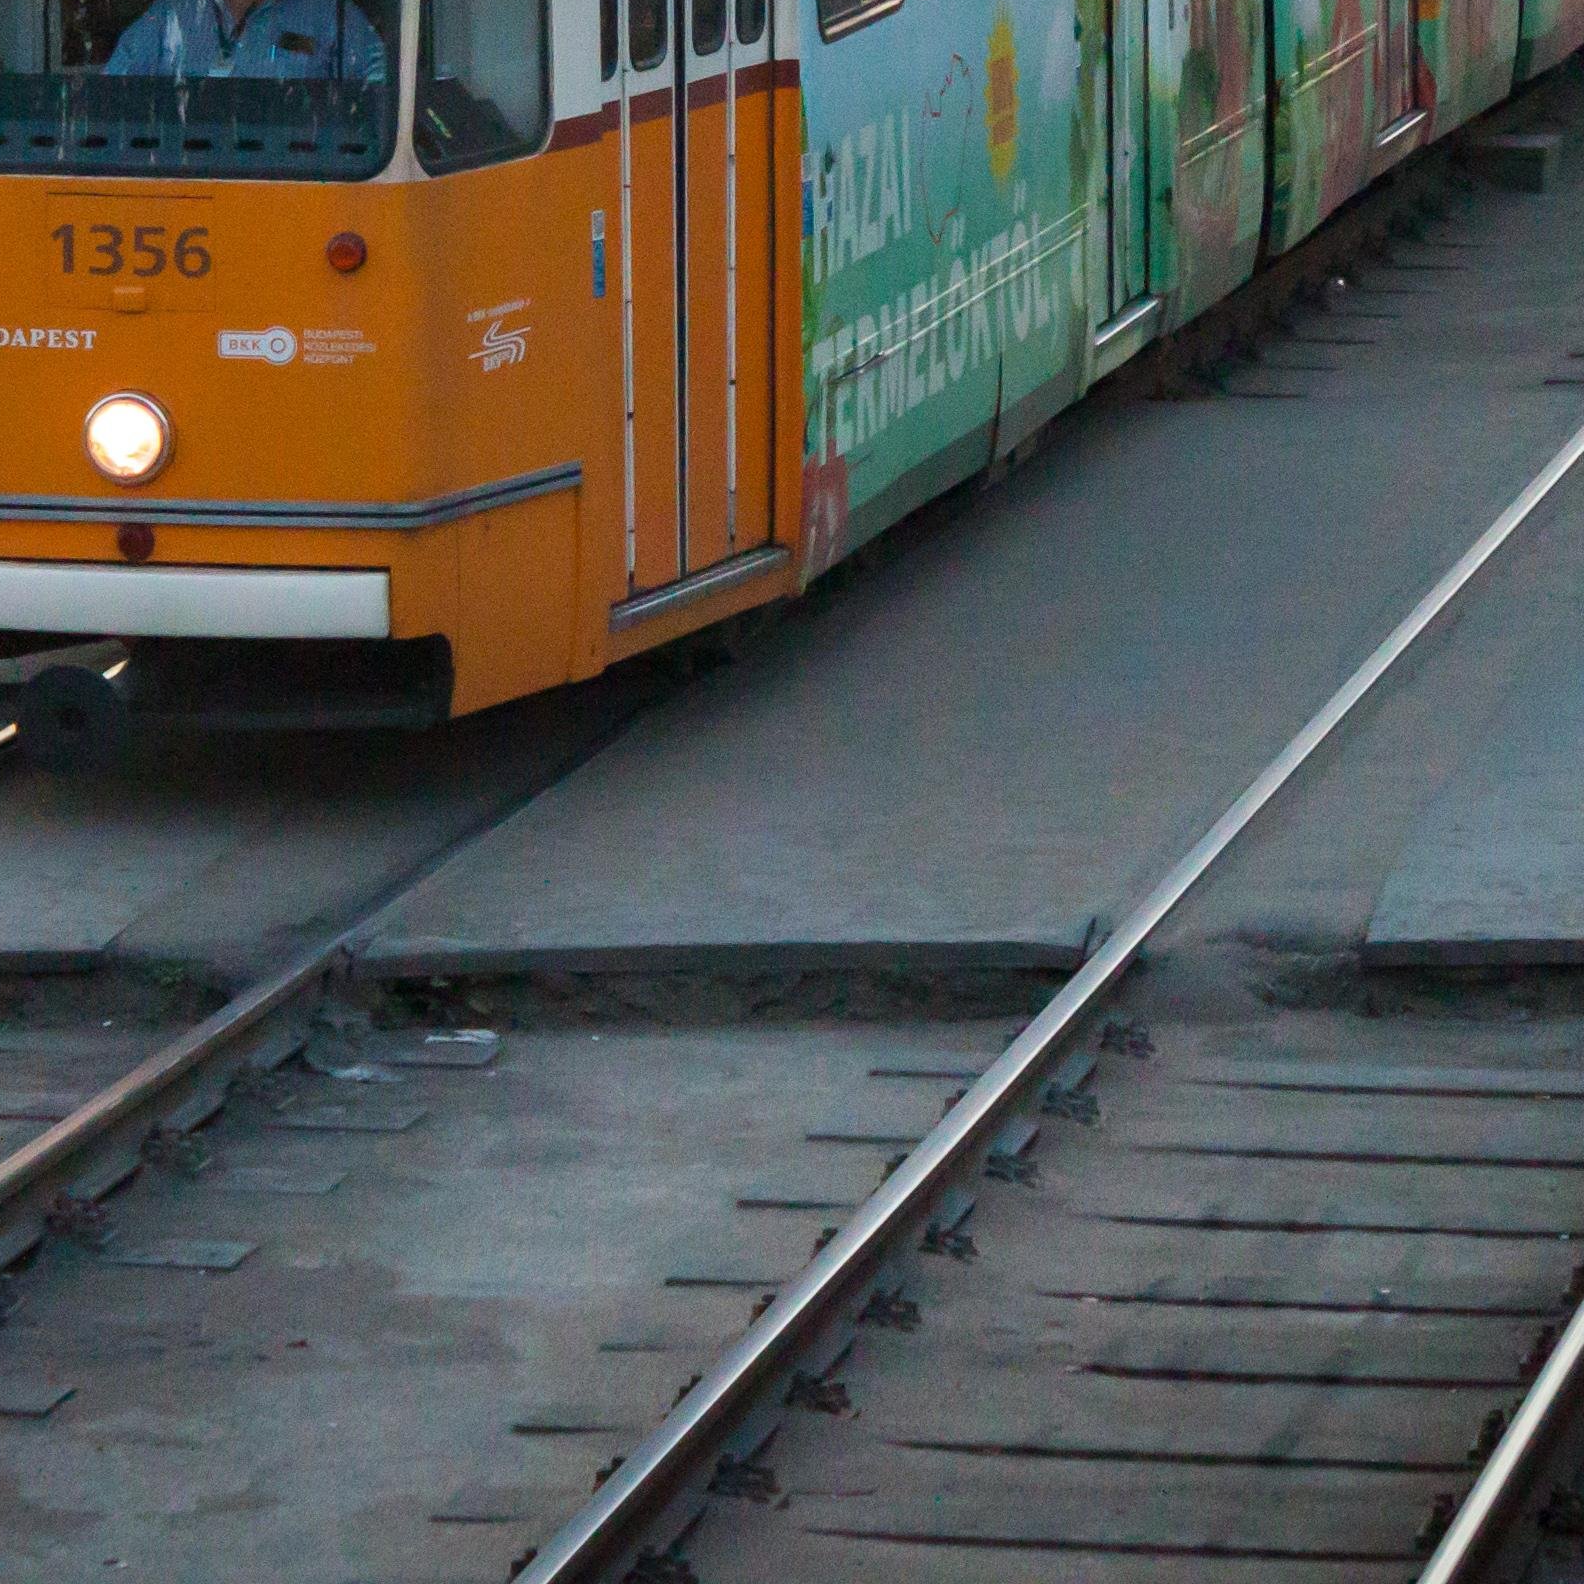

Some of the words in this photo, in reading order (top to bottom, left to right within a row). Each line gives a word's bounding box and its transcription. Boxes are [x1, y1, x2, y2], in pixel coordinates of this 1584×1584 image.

[812, 106, 913, 285] HAZAI
[51, 223, 213, 278] 1356
[228, 339, 261, 351] BKK
